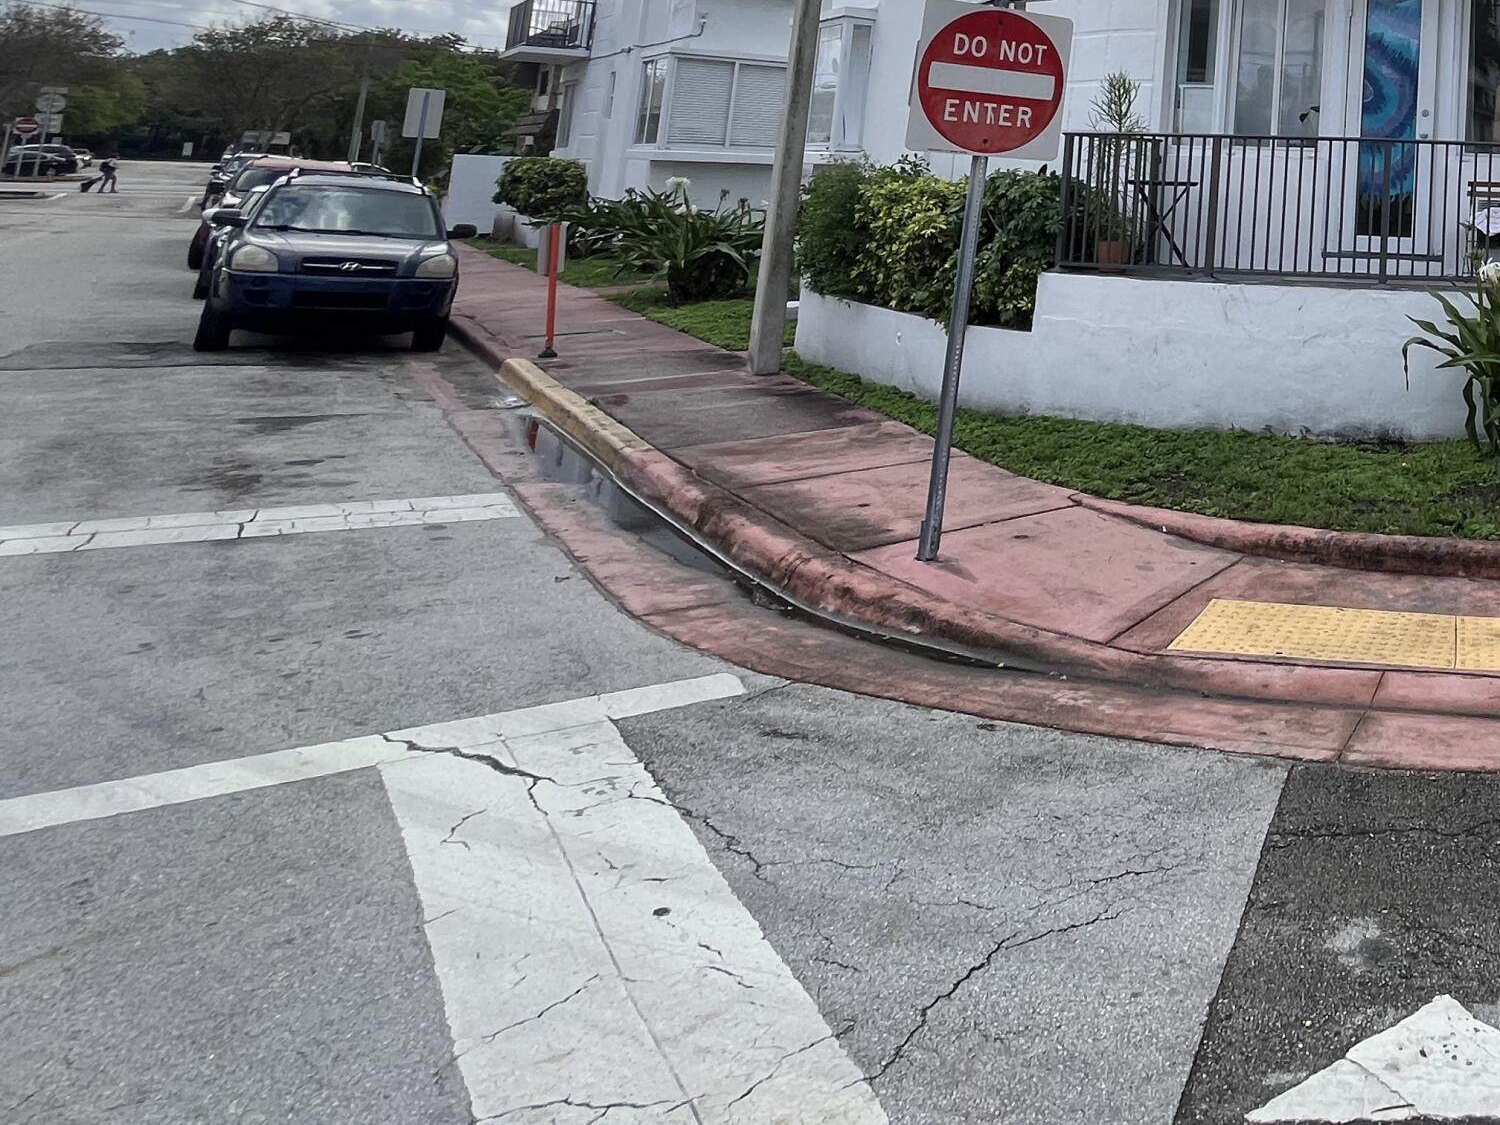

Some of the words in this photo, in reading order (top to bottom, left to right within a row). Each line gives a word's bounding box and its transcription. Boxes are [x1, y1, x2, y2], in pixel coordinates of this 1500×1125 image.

[953, 33, 988, 57] DO
[999, 39, 1048, 66] NOT
[943, 98, 1032, 129] ENTER
